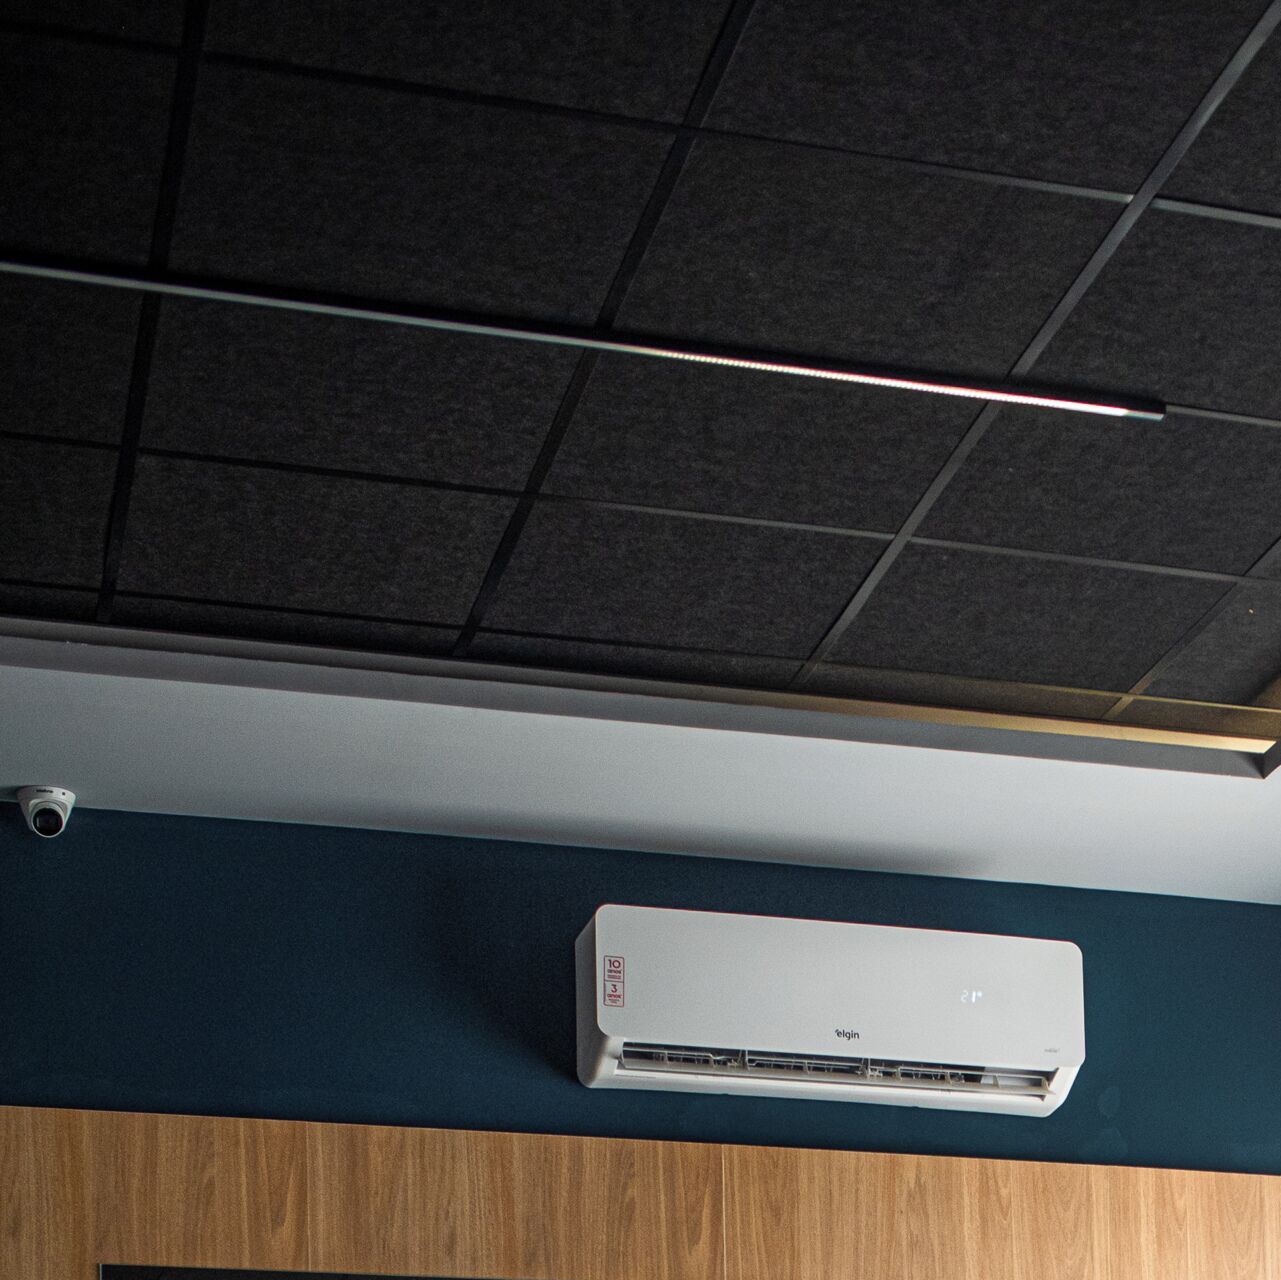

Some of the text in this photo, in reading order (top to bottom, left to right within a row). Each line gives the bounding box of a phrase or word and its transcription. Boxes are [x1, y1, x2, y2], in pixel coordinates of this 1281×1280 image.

[607, 959, 622, 969] 10
[611, 983, 618, 993] 3
[835, 1029, 860, 1041] elgin
